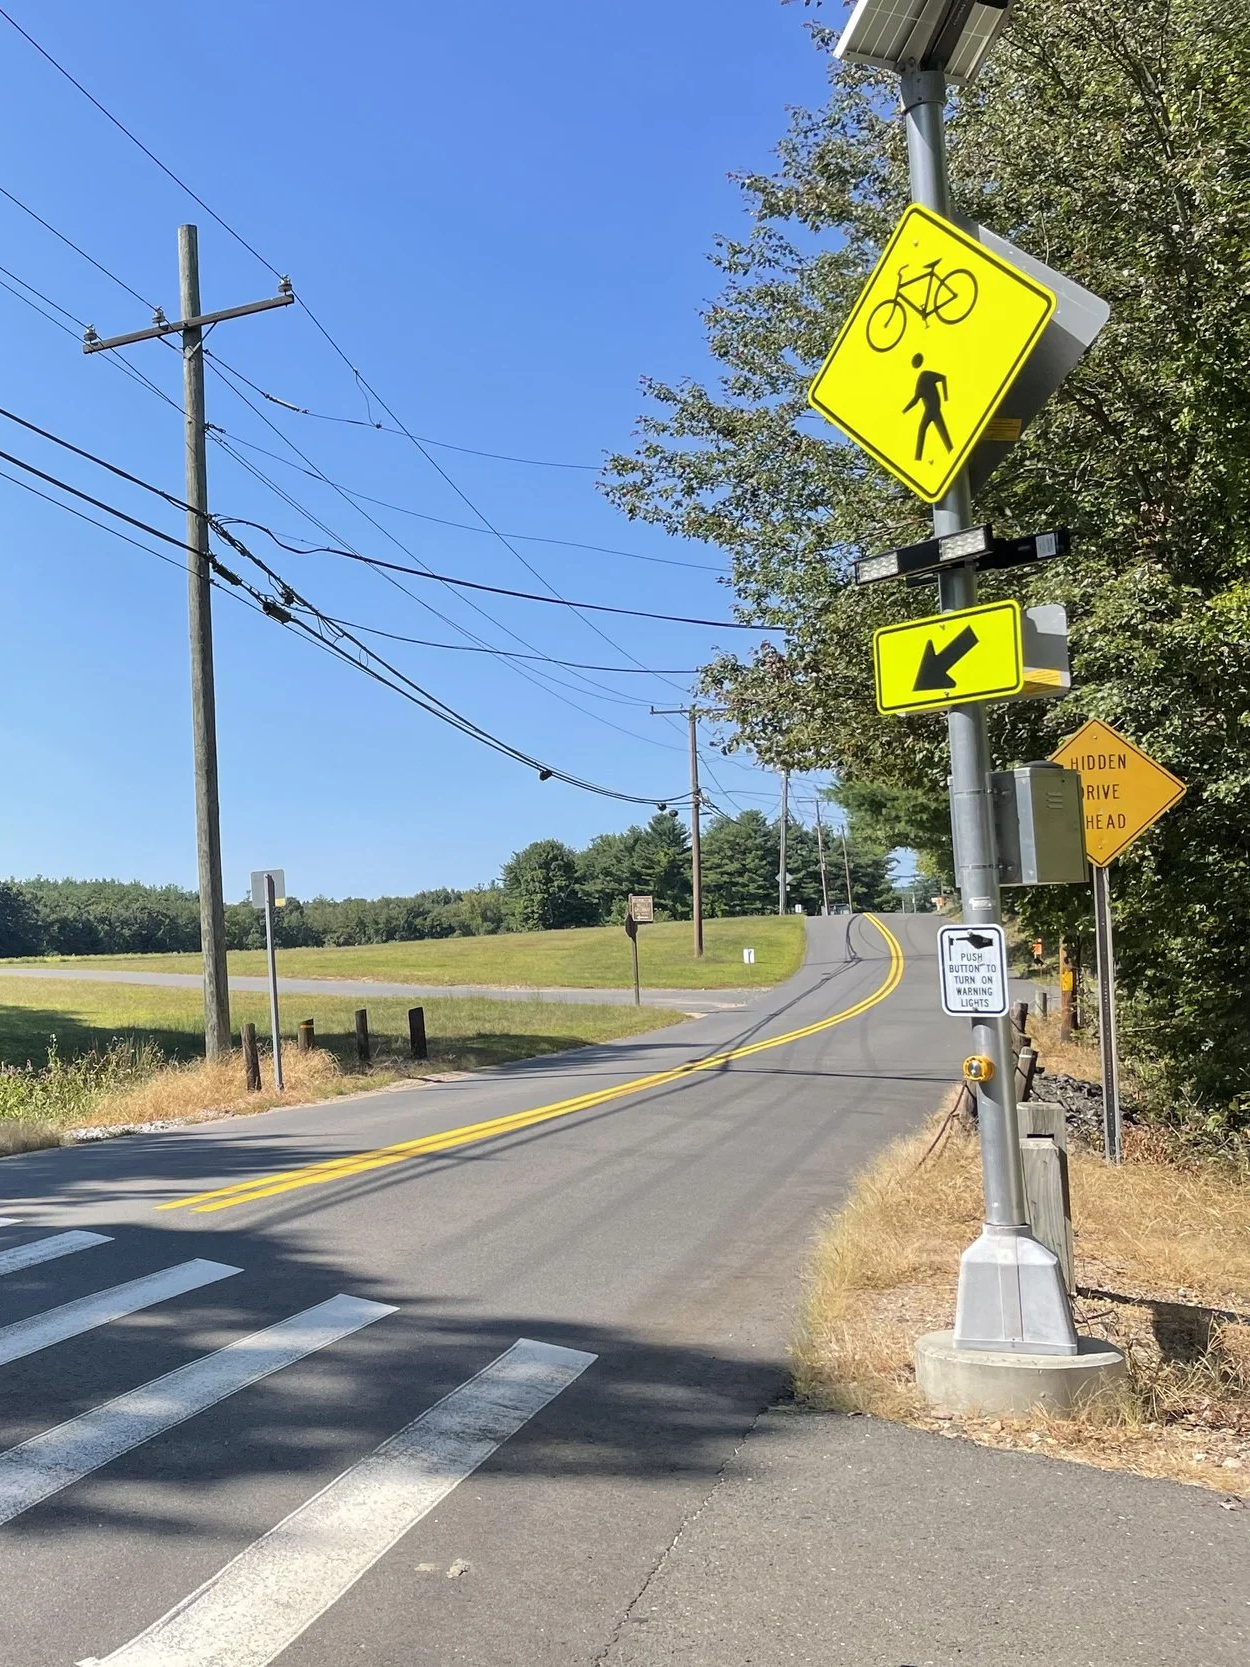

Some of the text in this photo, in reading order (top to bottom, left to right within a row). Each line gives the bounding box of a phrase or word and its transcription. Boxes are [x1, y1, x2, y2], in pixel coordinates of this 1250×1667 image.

[1070, 754, 1126, 770] HIDDEN
[1086, 813, 1126, 830] HEAD
[960, 953, 983, 961] PUSH
[949, 964, 997, 973] BUTTON TO
[954, 975, 993, 984] TURN ON
[956, 987, 993, 996] WARNING
[960, 998, 989, 1007] LIGHTS
